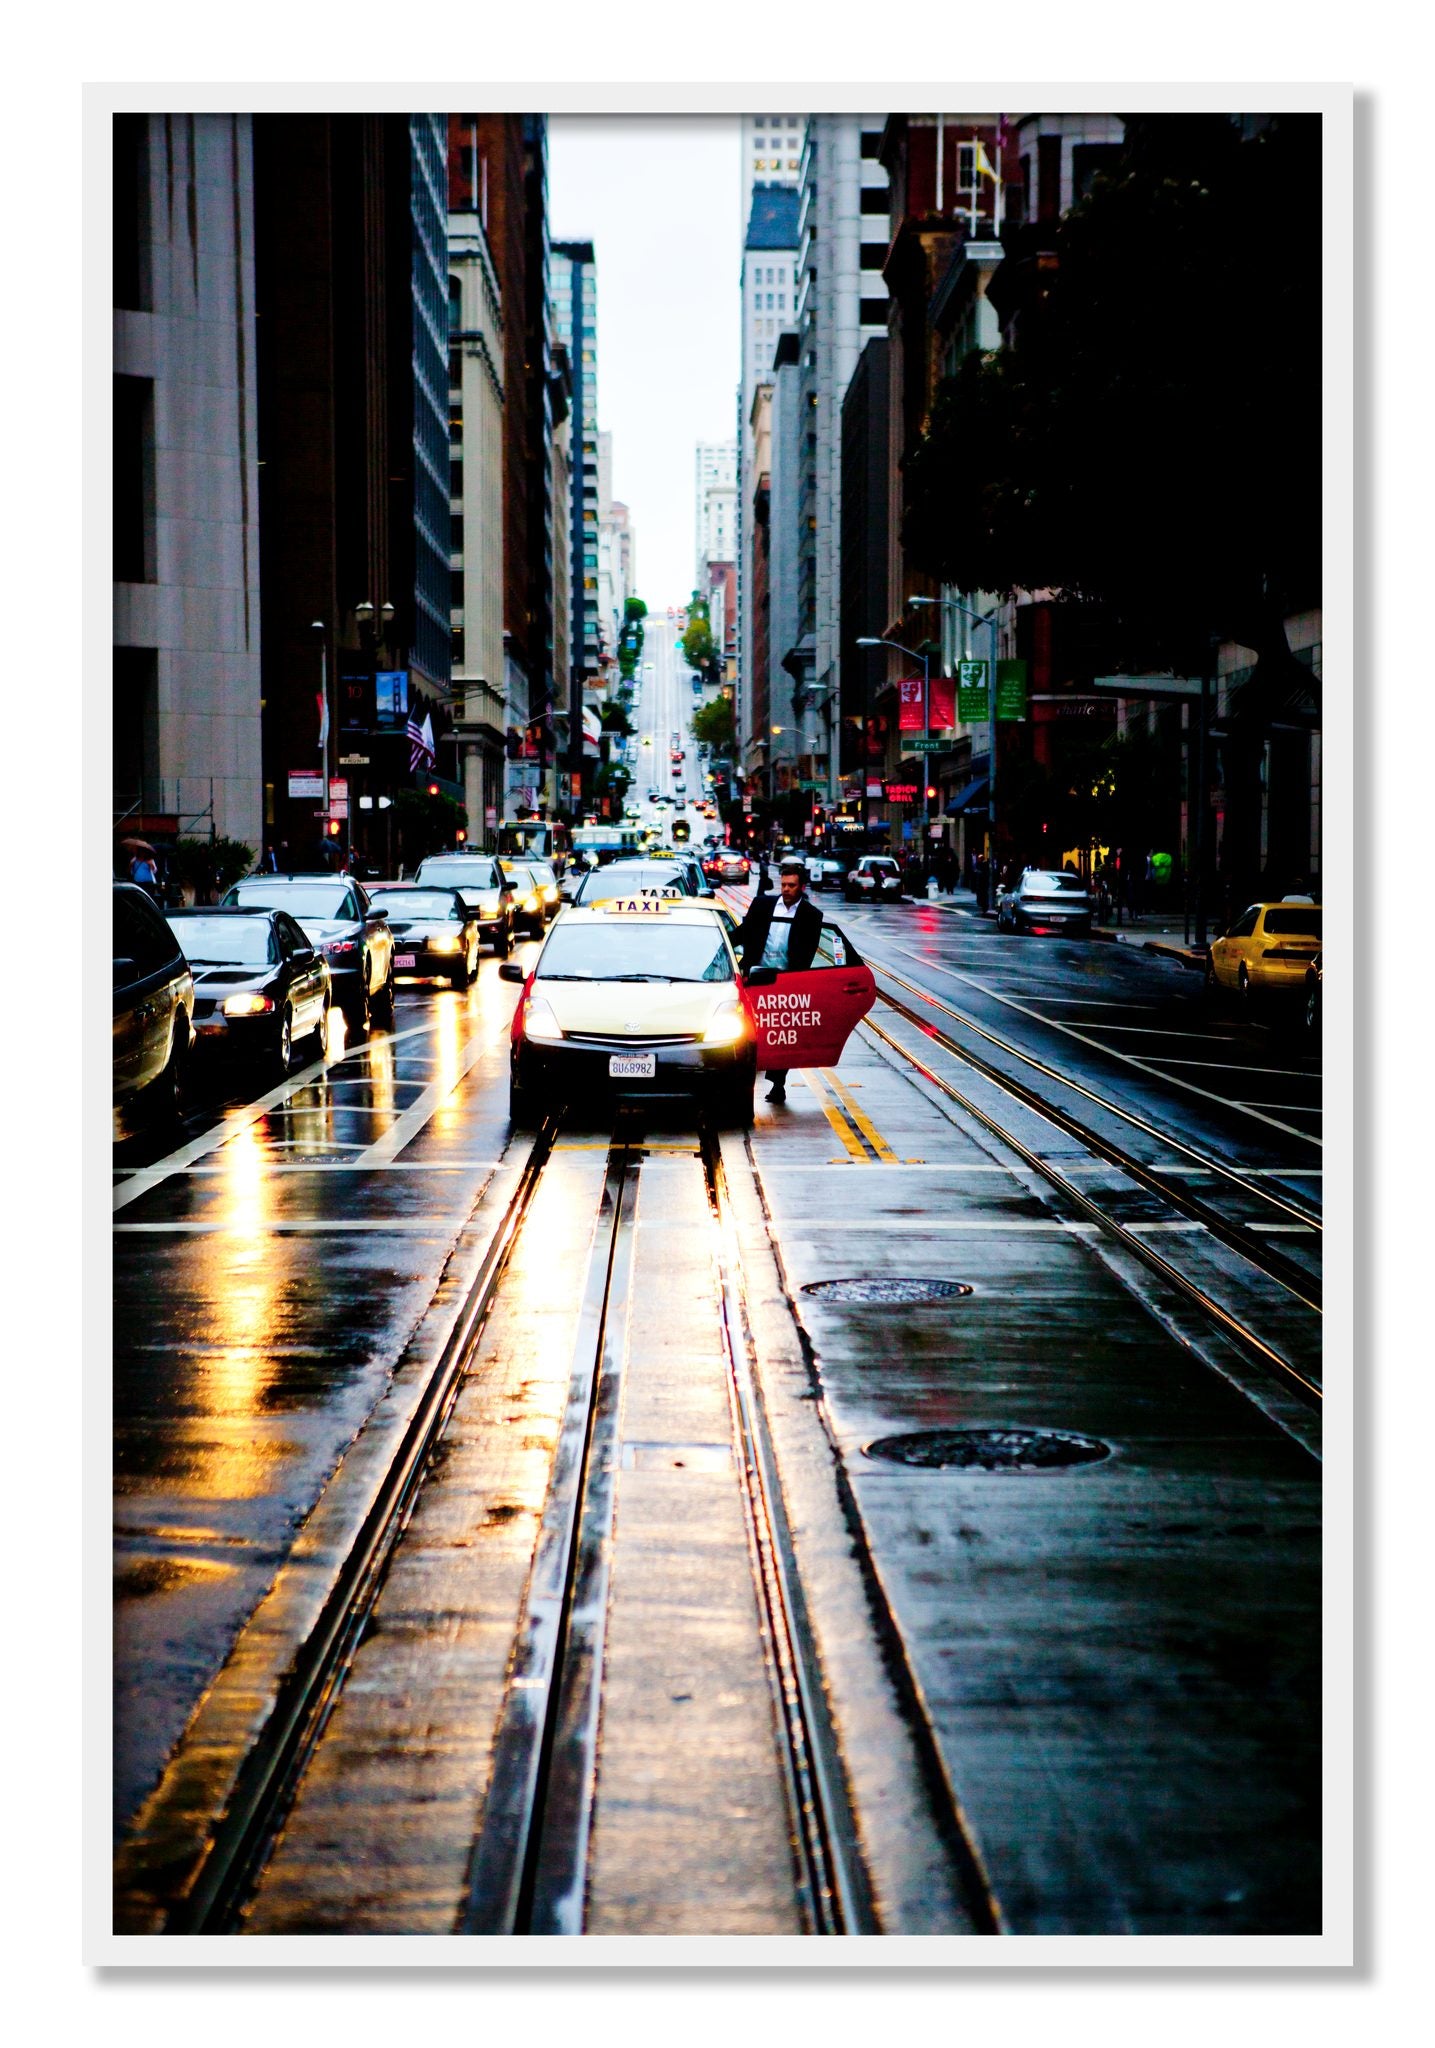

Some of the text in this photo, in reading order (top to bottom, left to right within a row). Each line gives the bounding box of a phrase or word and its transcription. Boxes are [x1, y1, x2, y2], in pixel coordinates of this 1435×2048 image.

[885, 784, 918, 794] TADICH
[888, 794, 914, 802] GRILL
[641, 889, 676, 898] TAXI
[616, 901, 660, 911] TAXI
[757, 994, 811, 1010] ARROW
[766, 1030, 798, 1045] CAB
[612, 1062, 652, 1074] 8U68982
